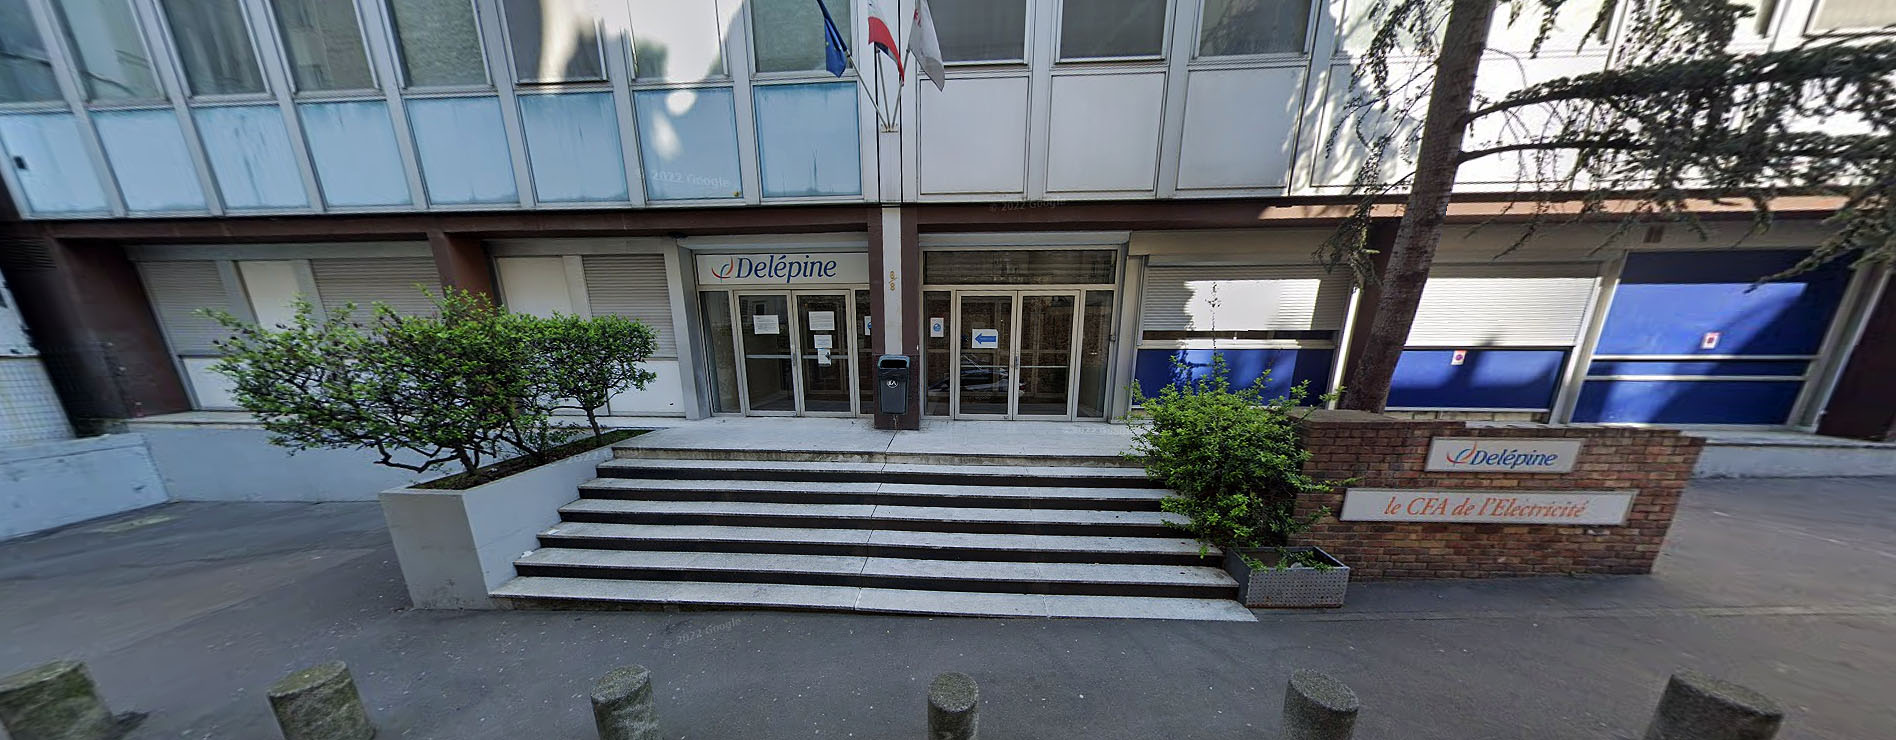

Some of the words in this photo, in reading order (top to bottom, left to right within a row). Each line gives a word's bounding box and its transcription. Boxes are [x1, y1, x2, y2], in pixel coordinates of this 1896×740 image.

[735, 254, 837, 284] Delépine
[1469, 449, 1559, 470] Delépine
[1383, 495, 1401, 516] le
[1406, 496, 1447, 516] CFA
[1451, 496, 1476, 516] de
[1478, 497, 1588, 518] l'Electricité
